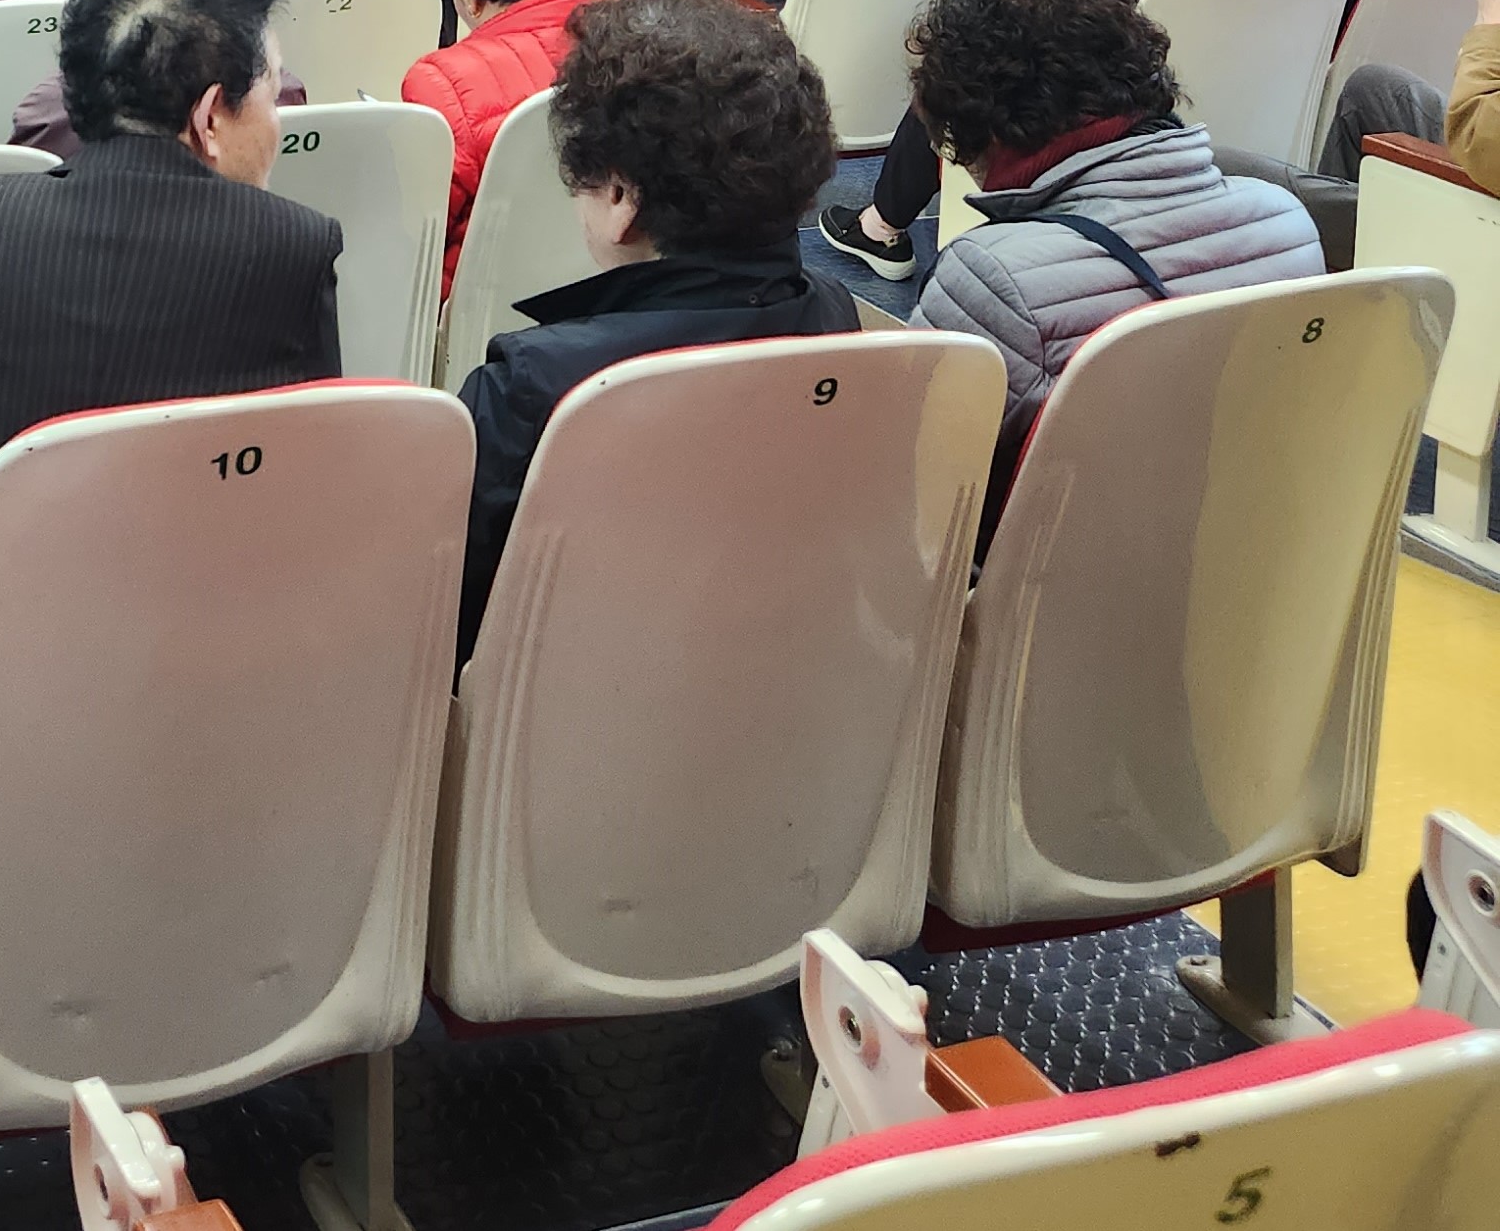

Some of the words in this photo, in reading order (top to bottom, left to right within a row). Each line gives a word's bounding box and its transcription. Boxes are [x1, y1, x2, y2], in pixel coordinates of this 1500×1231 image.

[27, 17, 57, 34] 23
[282, 131, 320, 154] 20
[1302, 317, 1325, 343] 8
[813, 378, 838, 406] 9
[210, 446, 262, 480] 10
[1215, 1166, 1271, 1224] 5
